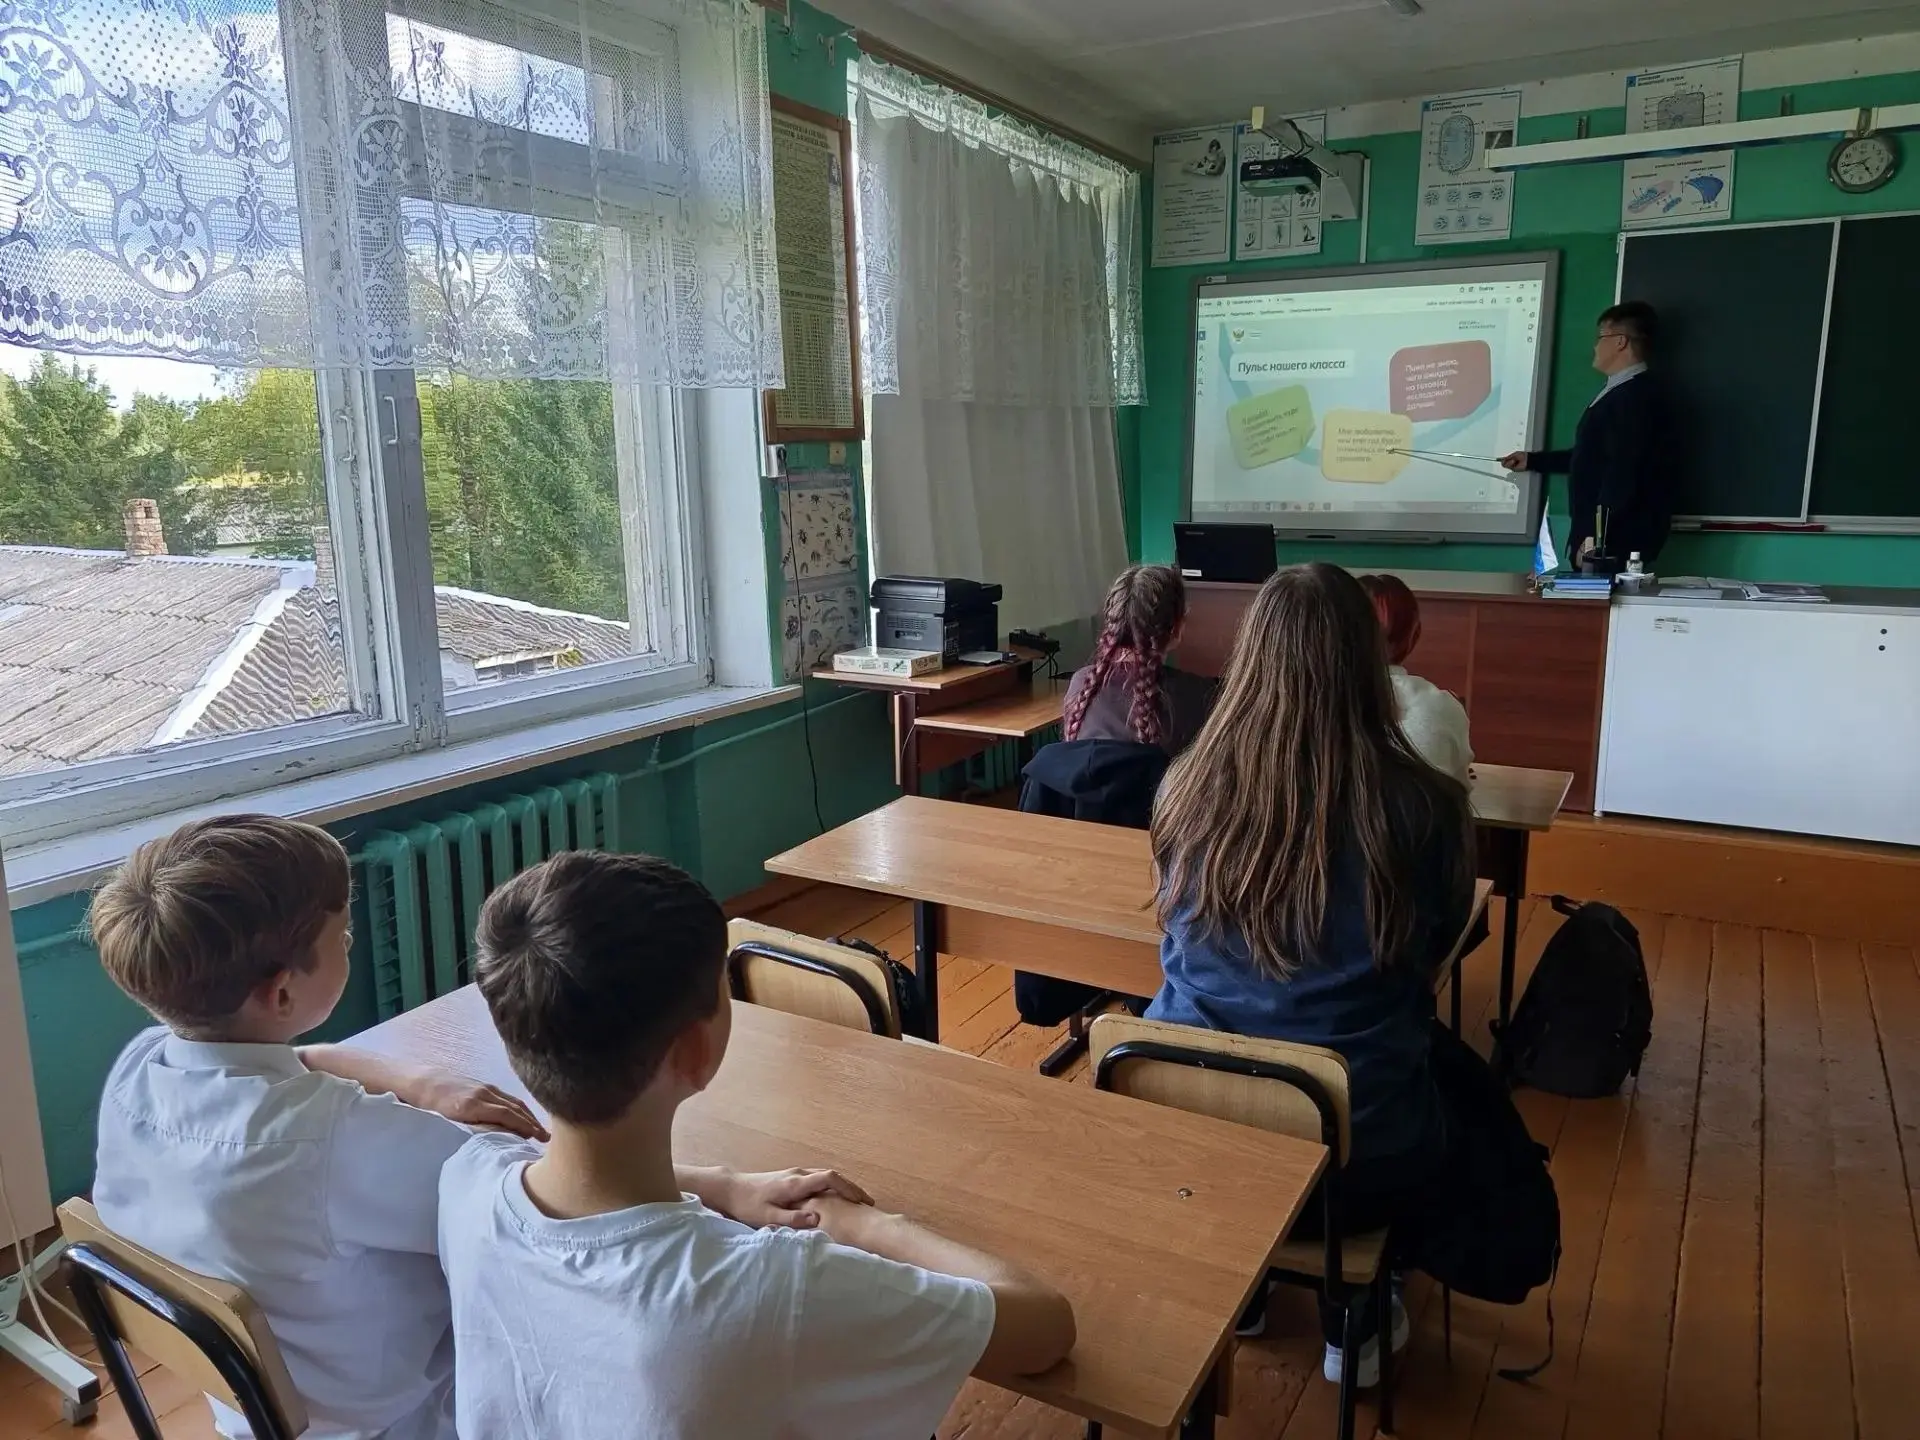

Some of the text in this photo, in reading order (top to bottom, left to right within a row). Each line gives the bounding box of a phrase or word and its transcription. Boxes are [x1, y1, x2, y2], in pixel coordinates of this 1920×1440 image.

[1238, 360, 1346, 375] Пульс нашего класса
